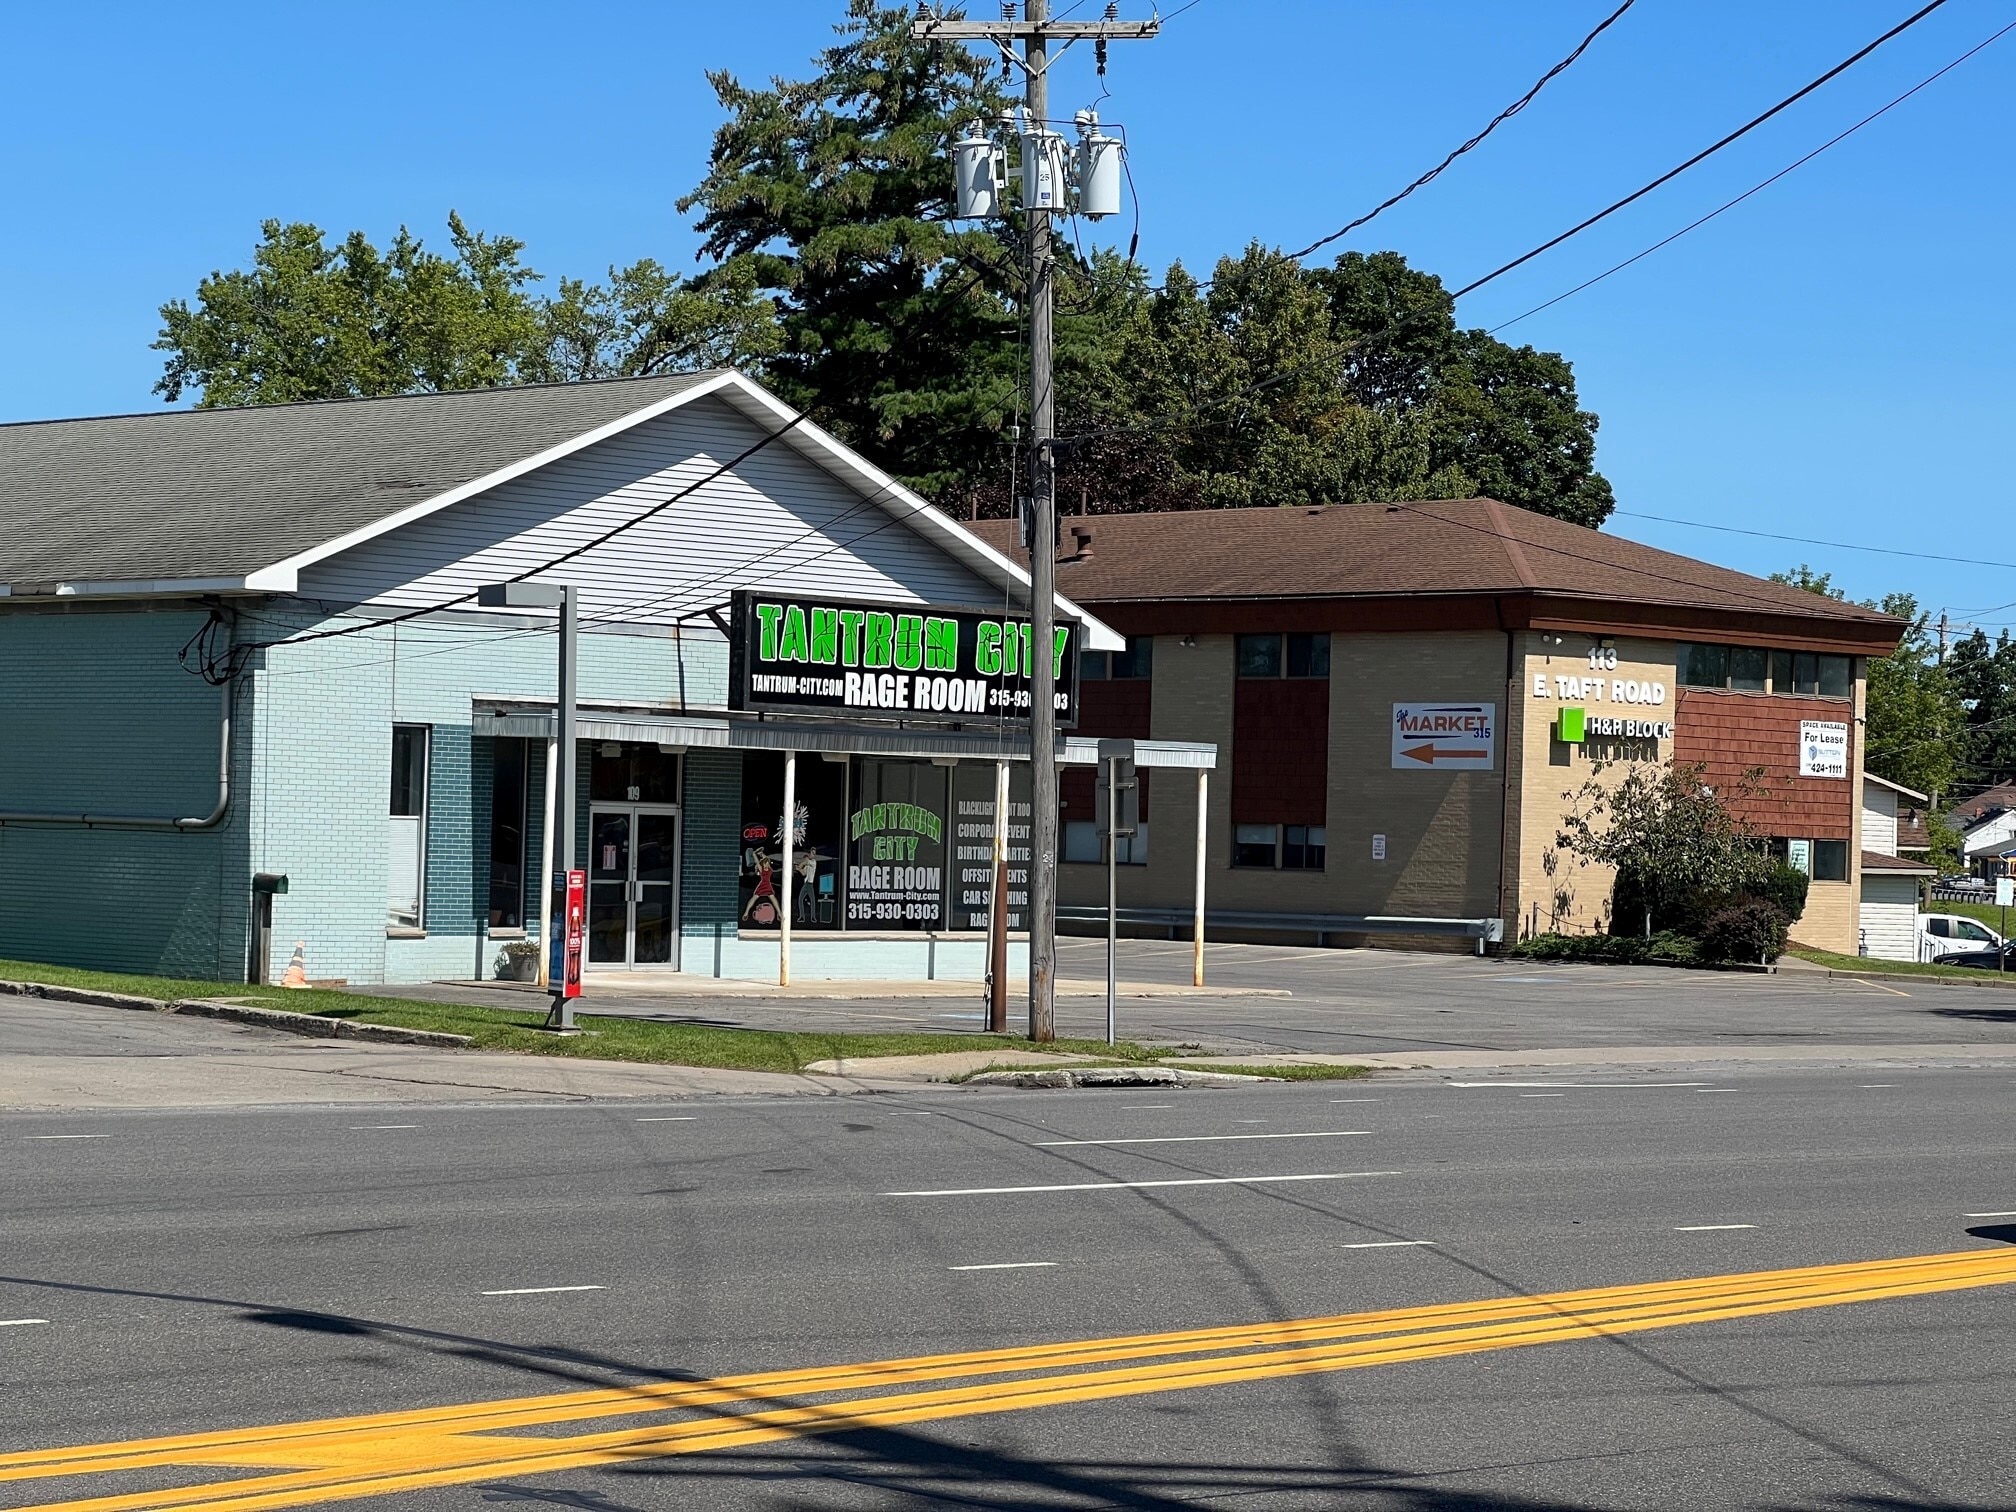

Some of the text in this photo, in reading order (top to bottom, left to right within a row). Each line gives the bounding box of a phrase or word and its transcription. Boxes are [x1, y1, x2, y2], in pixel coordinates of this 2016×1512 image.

[1040, 173, 1050, 182] 25
[756, 604, 1069, 680] TANTRUM CITY
[1587, 647, 1618, 670] 113
[752, 673, 843, 697] TANTRUM-CITY.COM
[844, 671, 987, 713] RAGE ROOM
[1533, 674, 1666, 705] E. TAFT ROAD
[989, 688, 1068, 710] 315-9303
[1400, 716, 1488, 731] MARKET
[1591, 717, 1671, 738] H&R BLOCK
[1474, 728, 1491, 738] 315
[1804, 732, 1844, 744] For Lease
[1811, 763, 1842, 774] 424-1111
[627, 786, 640, 800] 109
[1017, 802, 1030, 817] ROO
[851, 803, 941, 844] TANTRUM
[958, 824, 1030, 838] CORPOR EVENT
[744, 828, 767, 838] OPEN
[873, 836, 919, 860] CITY
[957, 846, 1031, 860] BIRTHD ARTIE
[849, 866, 940, 890] RAGE ROOM
[962, 868, 1028, 883] OFFSIT ENTS
[849, 890, 940, 901] www.Tantrum-City.com
[963, 890, 1028, 904] CAR SHING
[848, 903, 939, 920] 315-930-0303
[970, 913, 1020, 927] RAG OM
